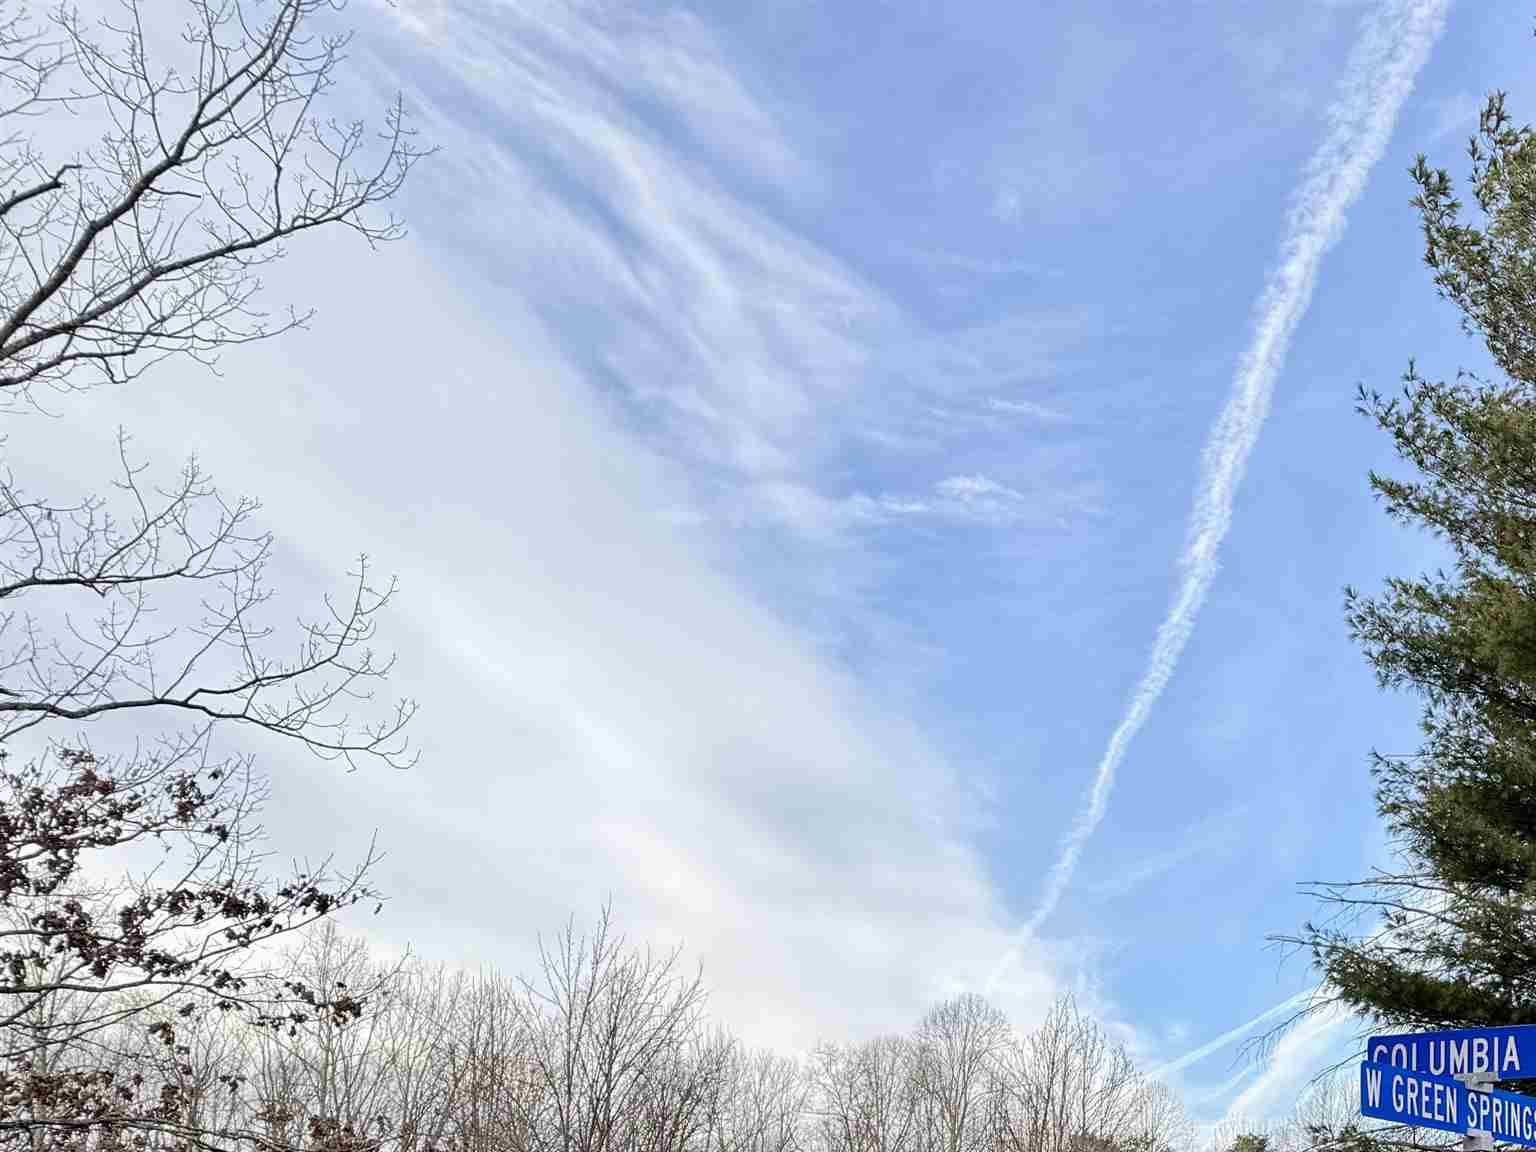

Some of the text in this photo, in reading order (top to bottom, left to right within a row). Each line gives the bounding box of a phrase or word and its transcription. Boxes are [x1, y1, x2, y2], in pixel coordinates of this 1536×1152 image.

[1373, 1035, 1520, 1075] COLUMBIA
[1366, 1068, 1382, 1108] W
[1392, 1075, 1457, 1124] GREEN
